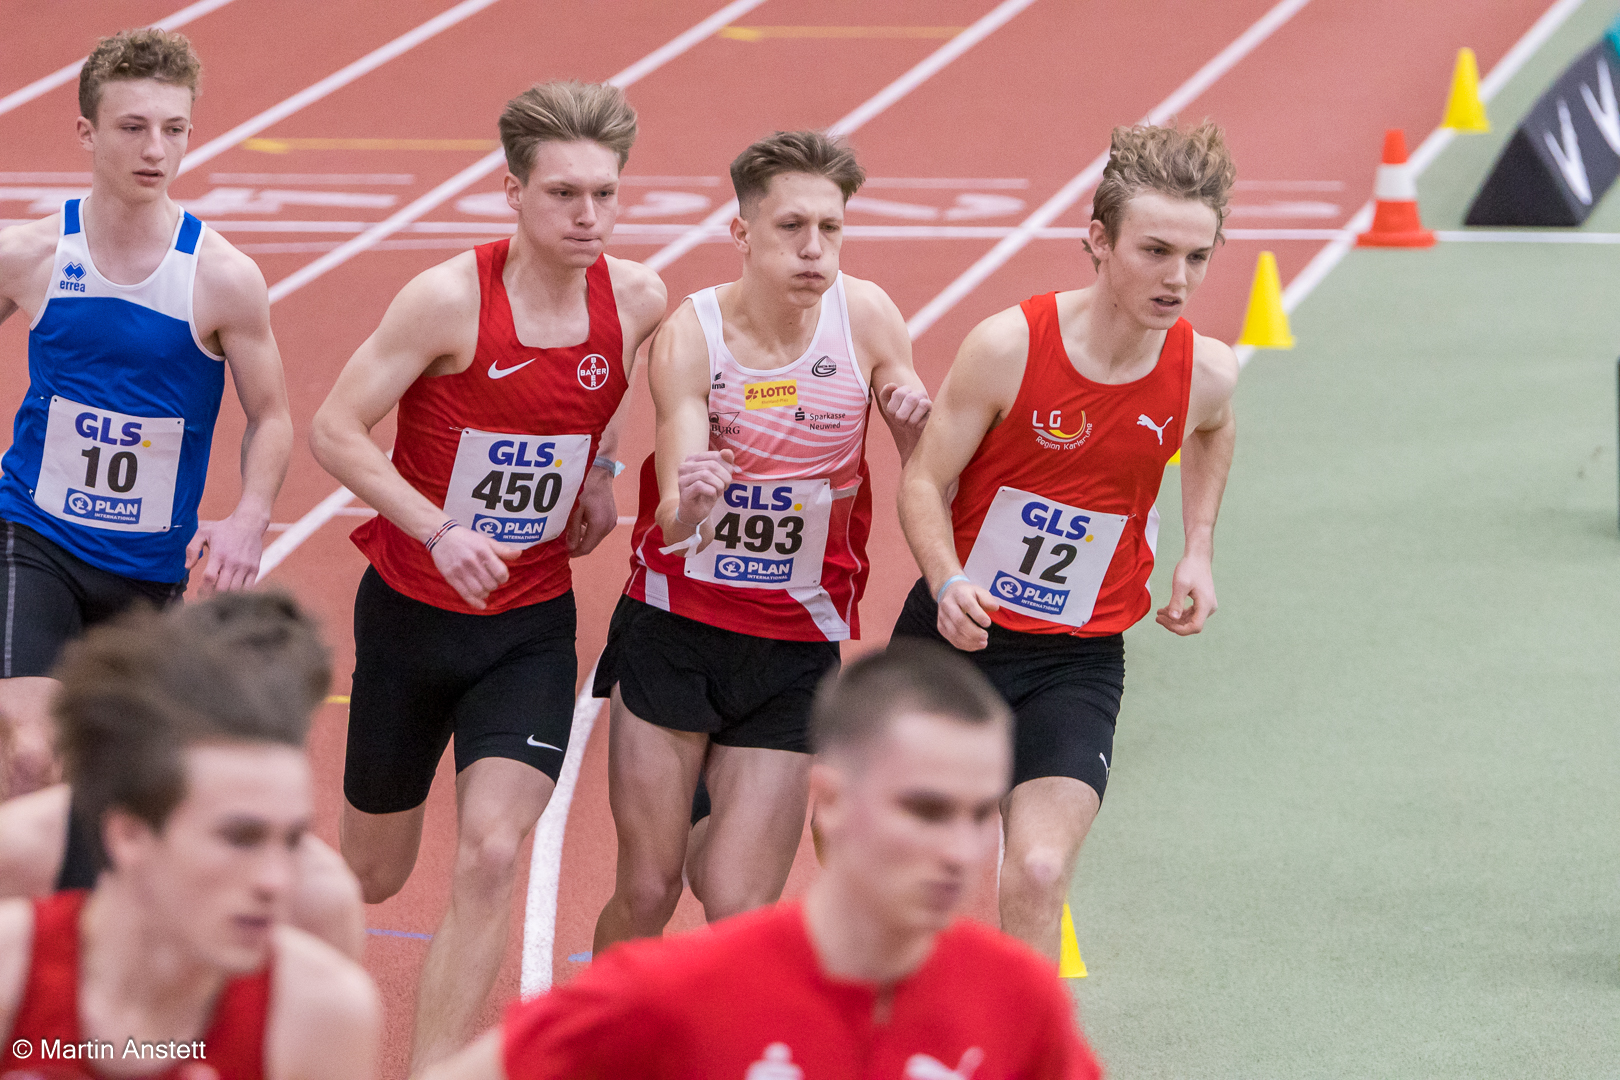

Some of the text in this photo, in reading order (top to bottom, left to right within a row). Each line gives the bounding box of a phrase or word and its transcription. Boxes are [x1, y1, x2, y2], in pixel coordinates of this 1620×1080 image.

[60, 280, 86, 293] errea
[580, 368, 607, 377] BAYER
[760, 385, 797, 398] LOTTO
[810, 412, 846, 421] Sparkasse
[711, 424, 740, 435] BURG
[810, 421, 841, 430] Neuwied
[1036, 423, 1093, 450] Region Karlsruhe
[81, 446, 138, 493] 10
[471, 470, 562, 513] 450
[95, 500, 138, 515] PLAN
[94, 512, 136, 521] INTERNATIONAL
[504, 522, 544, 534] PLAN
[714, 512, 804, 555] 493
[1018, 535, 1077, 585] 12
[747, 561, 790, 575] PLAN
[1023, 587, 1065, 606] PLAN
[1021, 599, 1060, 612] INTERNATIONAL
